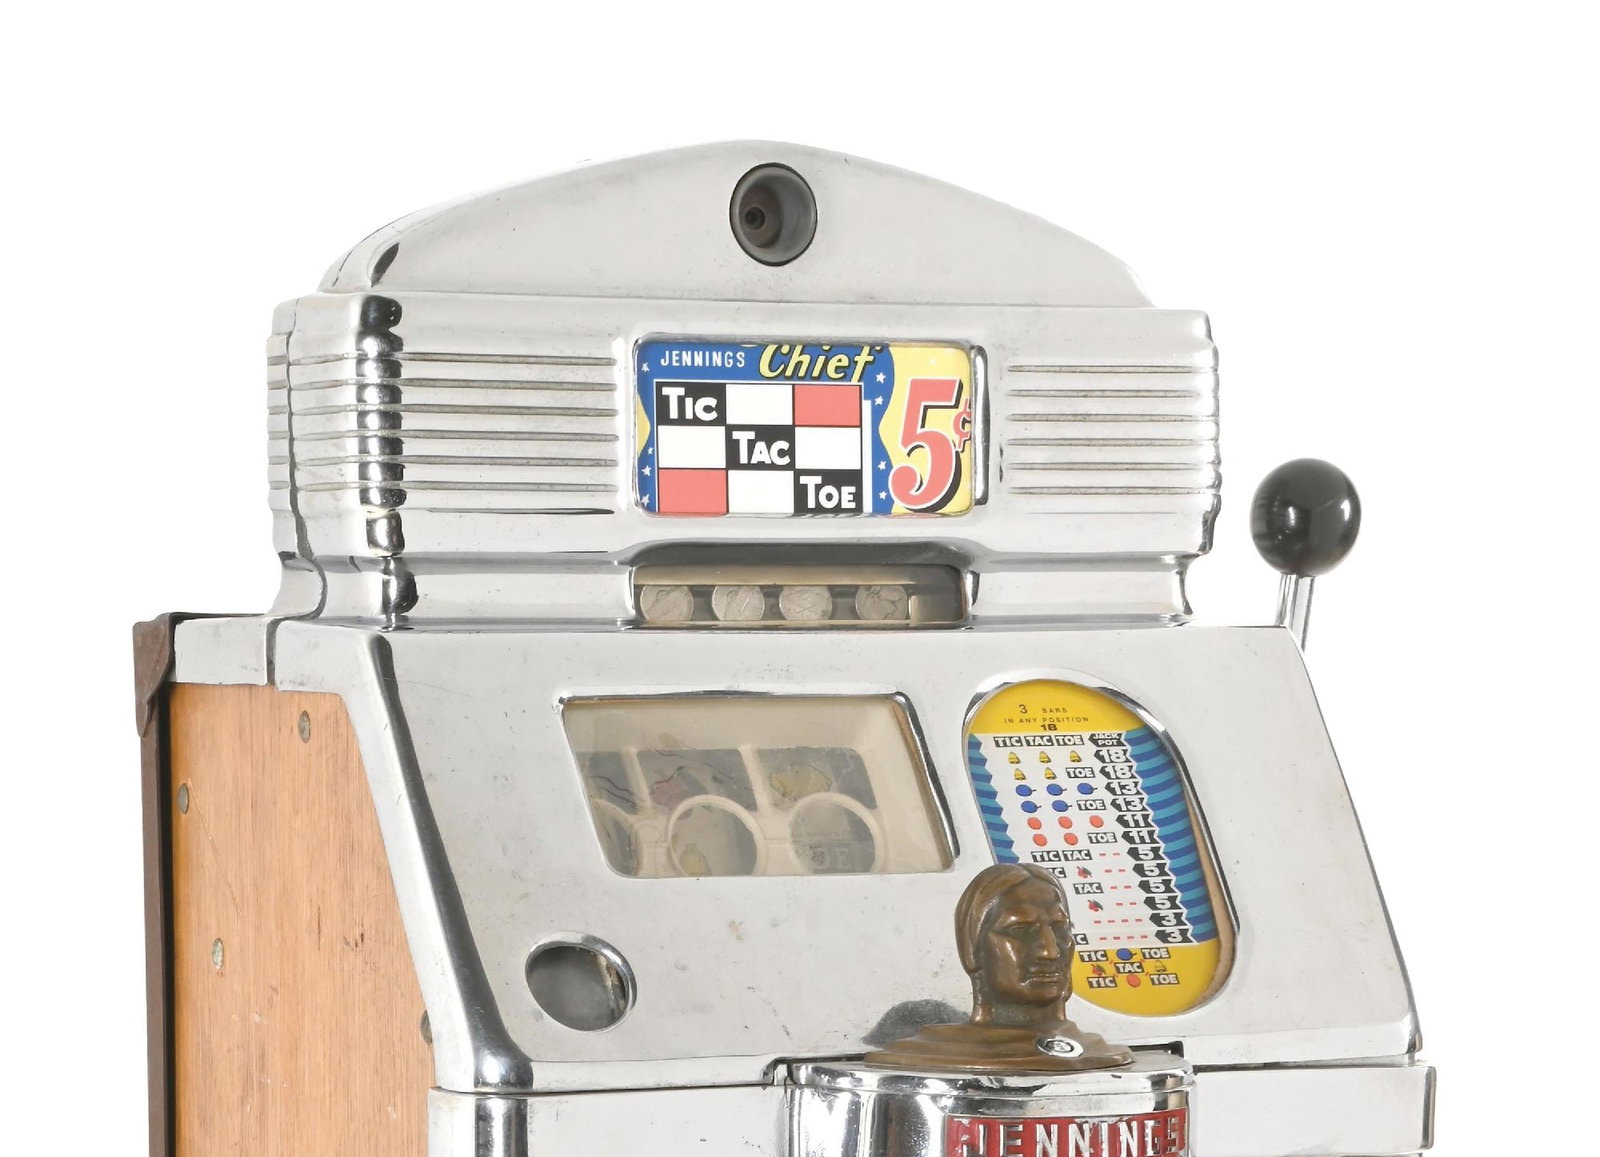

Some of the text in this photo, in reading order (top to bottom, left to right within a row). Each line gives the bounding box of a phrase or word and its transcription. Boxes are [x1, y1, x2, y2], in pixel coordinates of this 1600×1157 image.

[660, 344, 878, 384] JENNINGS Chief
[661, 387, 719, 421] TIC
[732, 430, 791, 466] TAC
[799, 475, 857, 509] TOE
[1018, 704, 1028, 714] 3
[995, 735, 1083, 747] TIC TAC TOE
[1100, 749, 1127, 762] 18
[1067, 765, 1132, 779] TOE 18
[1110, 781, 1138, 795] 13
[1078, 797, 1143, 811] TOE 13
[1123, 814, 1146, 827] 11
[1089, 830, 1151, 843] TOE 11
[1032, 846, 1154, 861] TIC TAC 5
[1143, 862, 1160, 876] 5
[1074, 879, 1166, 893] TAC 5
[1154, 895, 1171, 909] 5
[1159, 912, 1177, 926] 3
[1165, 928, 1183, 942] 3
[1080, 948, 1169, 961] TIC TOE
[1115, 963, 1143, 973] TAC
[1088, 974, 1178, 988] TIC TOE
